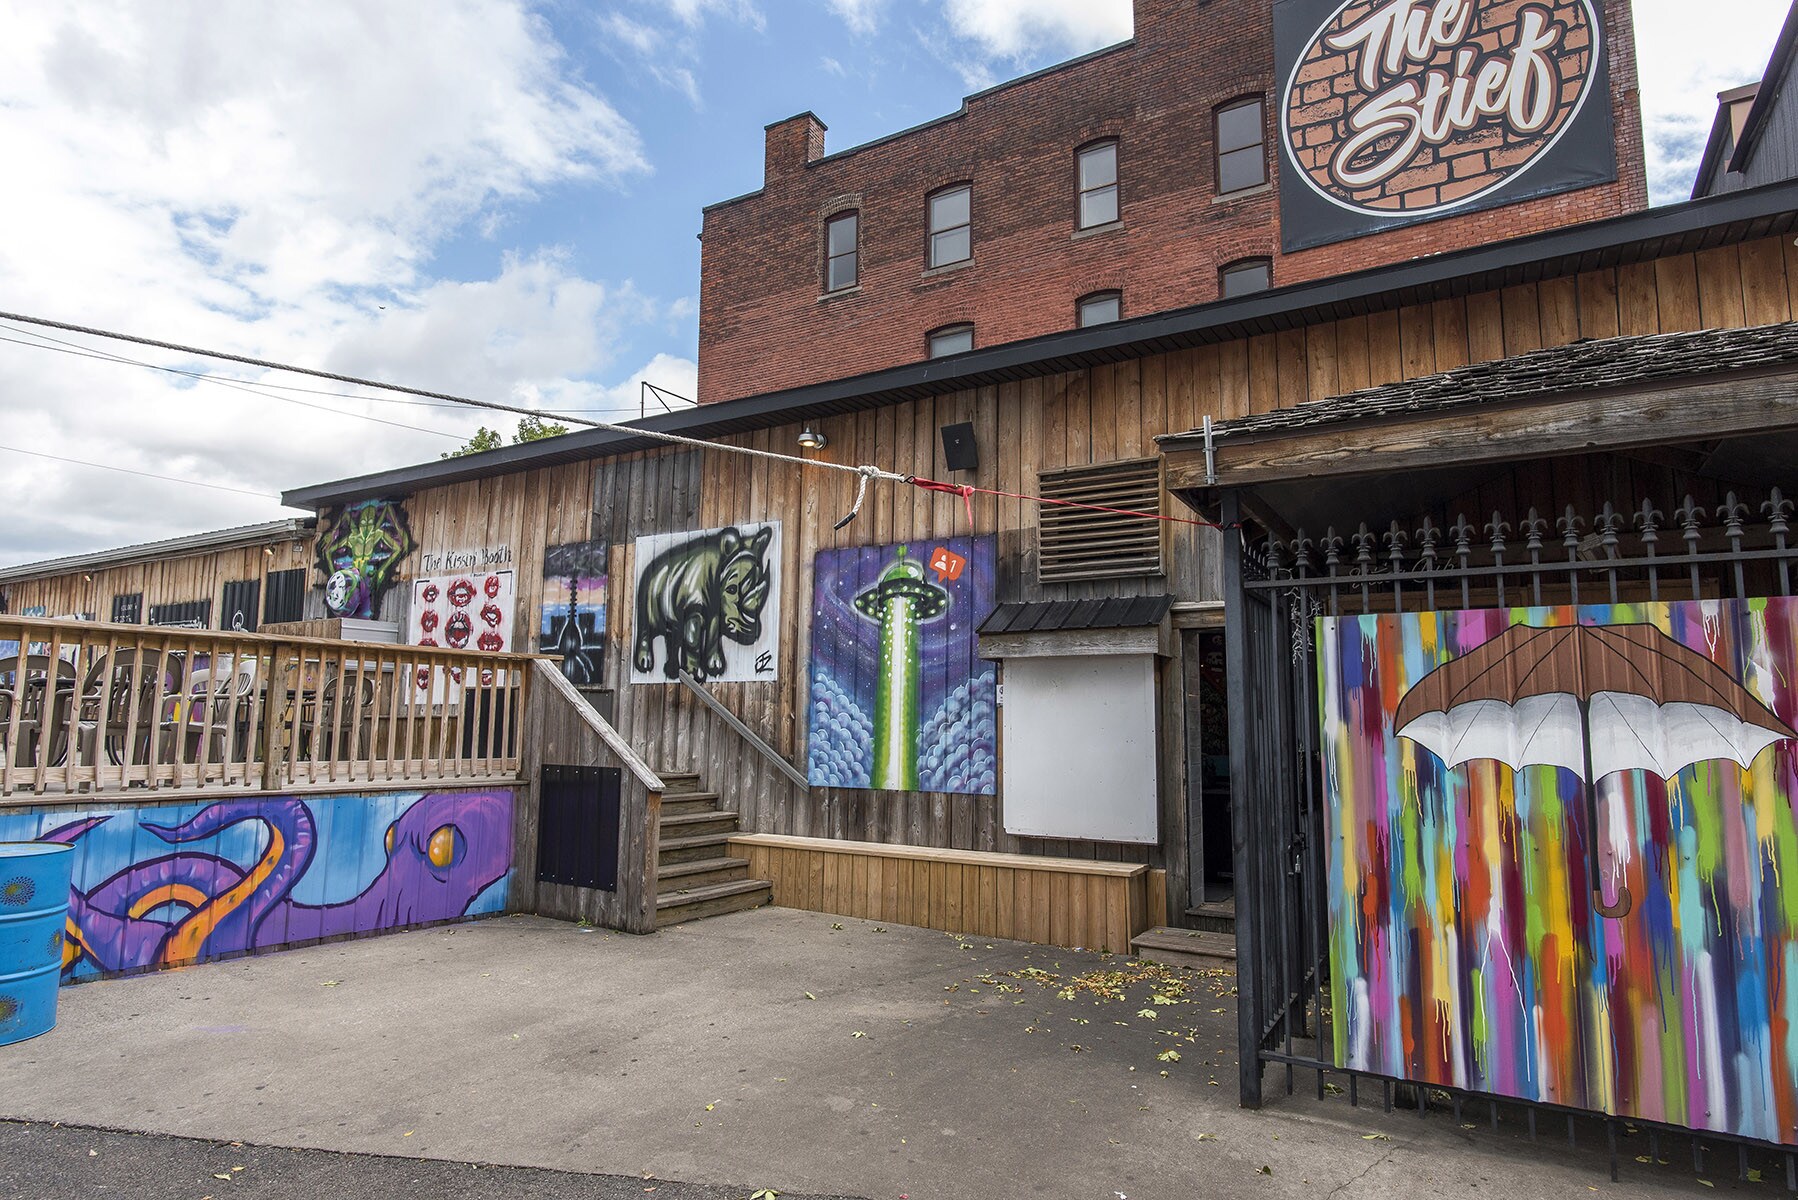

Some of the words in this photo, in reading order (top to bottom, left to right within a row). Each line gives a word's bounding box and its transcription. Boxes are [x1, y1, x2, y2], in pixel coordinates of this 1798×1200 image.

[1327, 0, 1471, 90] The
[1336, 10, 1557, 185] Stief
[423, 554, 442, 573] The
[481, 545, 513, 566] Booth
[949, 559, 958, 573] 1
